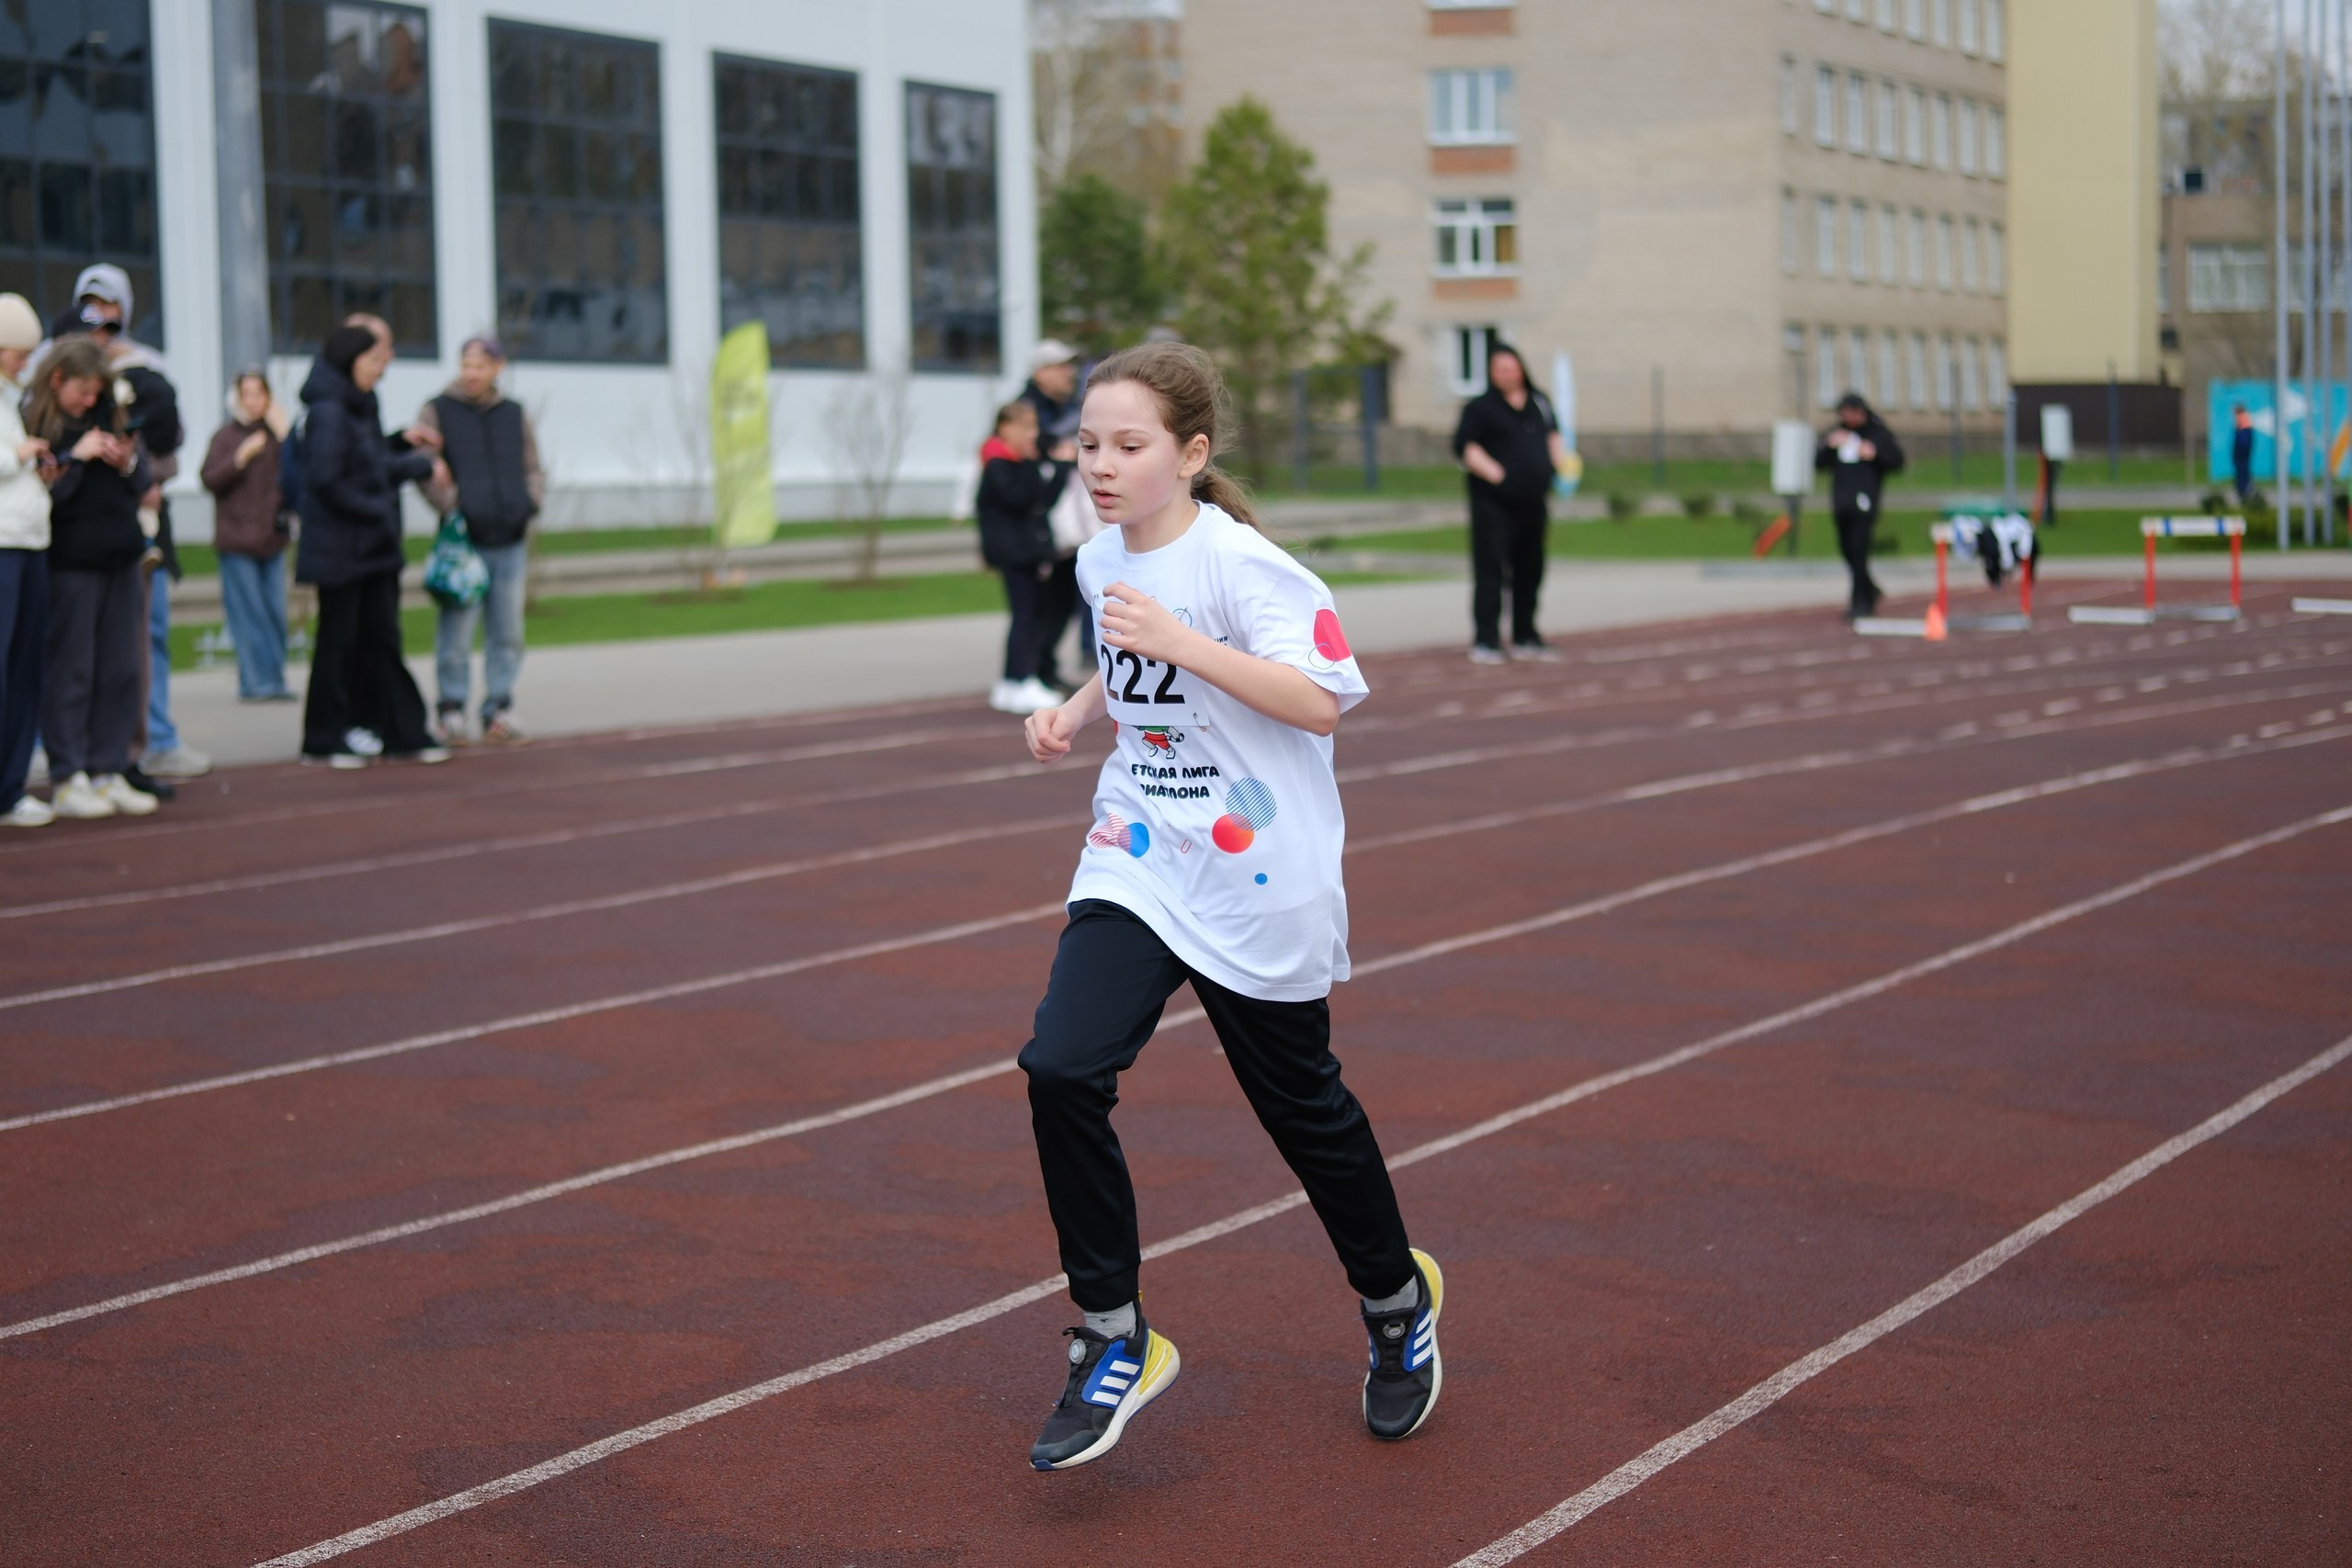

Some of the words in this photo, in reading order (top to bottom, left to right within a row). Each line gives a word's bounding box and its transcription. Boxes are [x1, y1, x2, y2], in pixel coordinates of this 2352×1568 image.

[1101, 644, 1185, 705] 222
[1131, 763, 1177, 780] ЕТСКАЯ
[1182, 765, 1220, 779] ЛИГА
